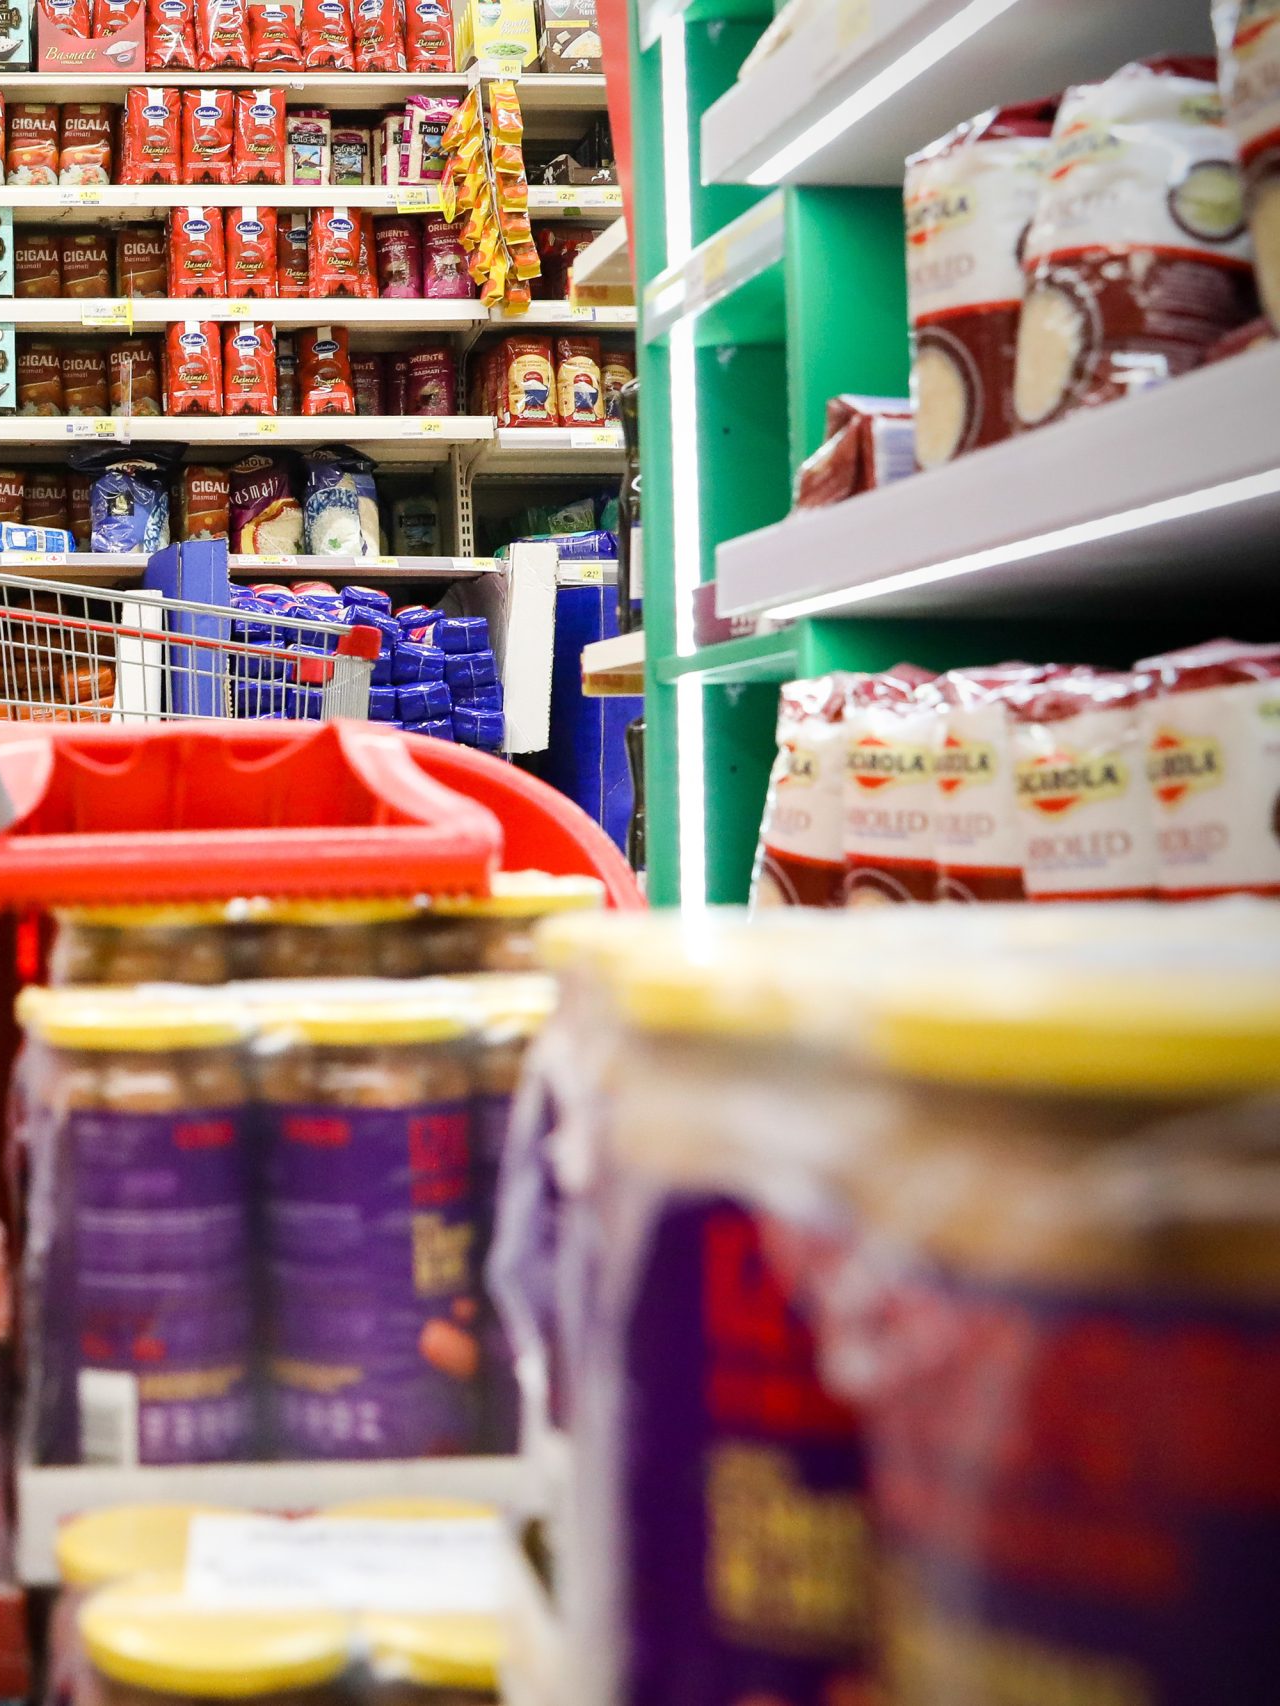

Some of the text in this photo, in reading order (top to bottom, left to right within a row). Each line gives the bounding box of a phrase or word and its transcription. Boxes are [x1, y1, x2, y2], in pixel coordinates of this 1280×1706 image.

[45, 46, 97, 60] Basmati
[11, 118, 57, 131] CIGALA
[65, 118, 110, 132] CIGALA
[422, 125, 439, 133] Pato
[15, 250, 58, 262] CIGALA
[63, 250, 108, 262] CIGALA
[18, 354, 60, 369] CIGALA
[62, 359, 106, 371] CIGALA
[72, 488, 90, 501] CIG
